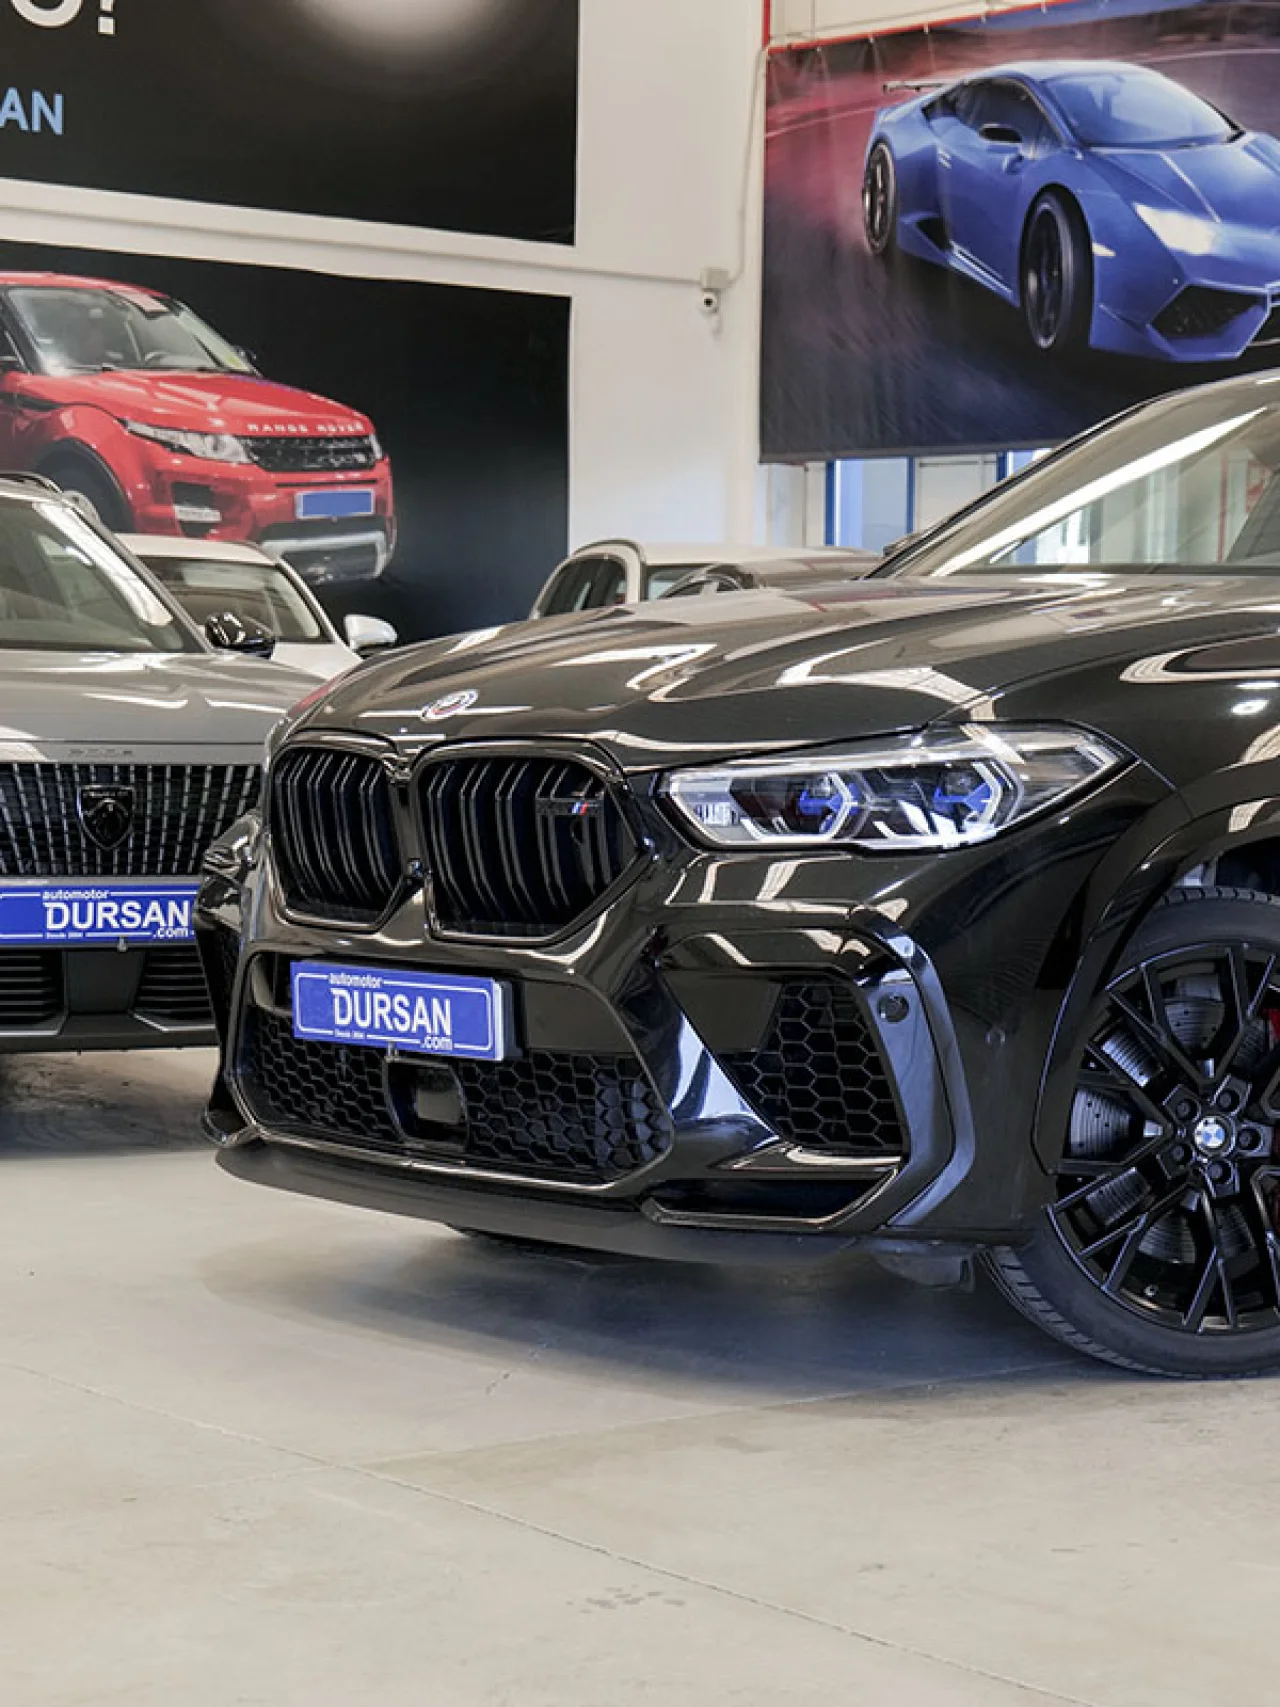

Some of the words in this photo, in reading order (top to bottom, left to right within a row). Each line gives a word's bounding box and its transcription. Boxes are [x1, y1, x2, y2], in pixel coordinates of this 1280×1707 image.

[43, 889, 109, 900] automotor
[43, 900, 189, 930] DURSAN
[153, 926, 189, 938] .com
[330, 972, 383, 989] automotor
[330, 987, 451, 1036] DURSAN
[420, 1034, 453, 1051] .com
